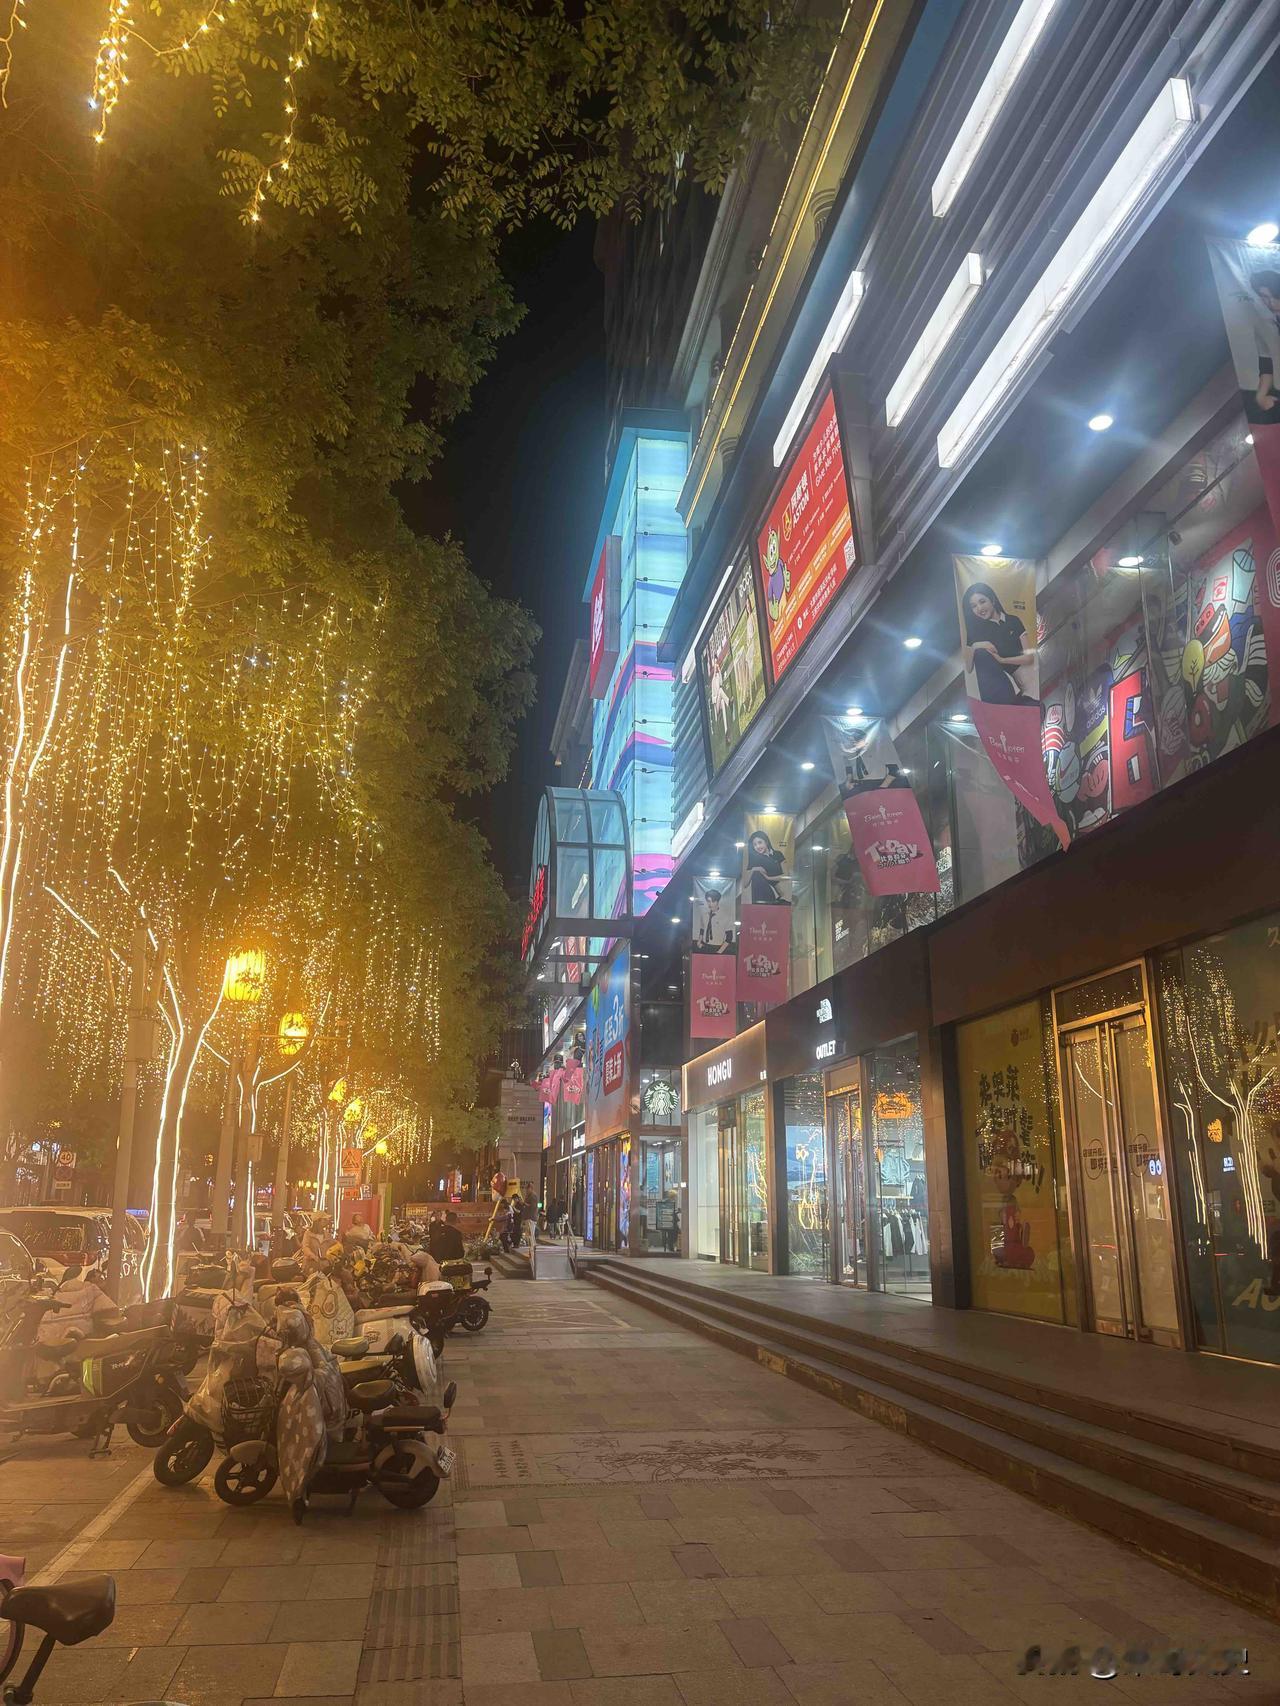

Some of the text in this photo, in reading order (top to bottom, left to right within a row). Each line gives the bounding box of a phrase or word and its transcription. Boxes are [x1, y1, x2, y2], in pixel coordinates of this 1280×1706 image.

[793, 490, 809, 528] ASTON
[1086, 705, 1106, 729] adidas
[816, 1040, 837, 1060] OUTLET
[707, 1058, 732, 1087] HONGU
[61, 1153, 71, 1161] 40
